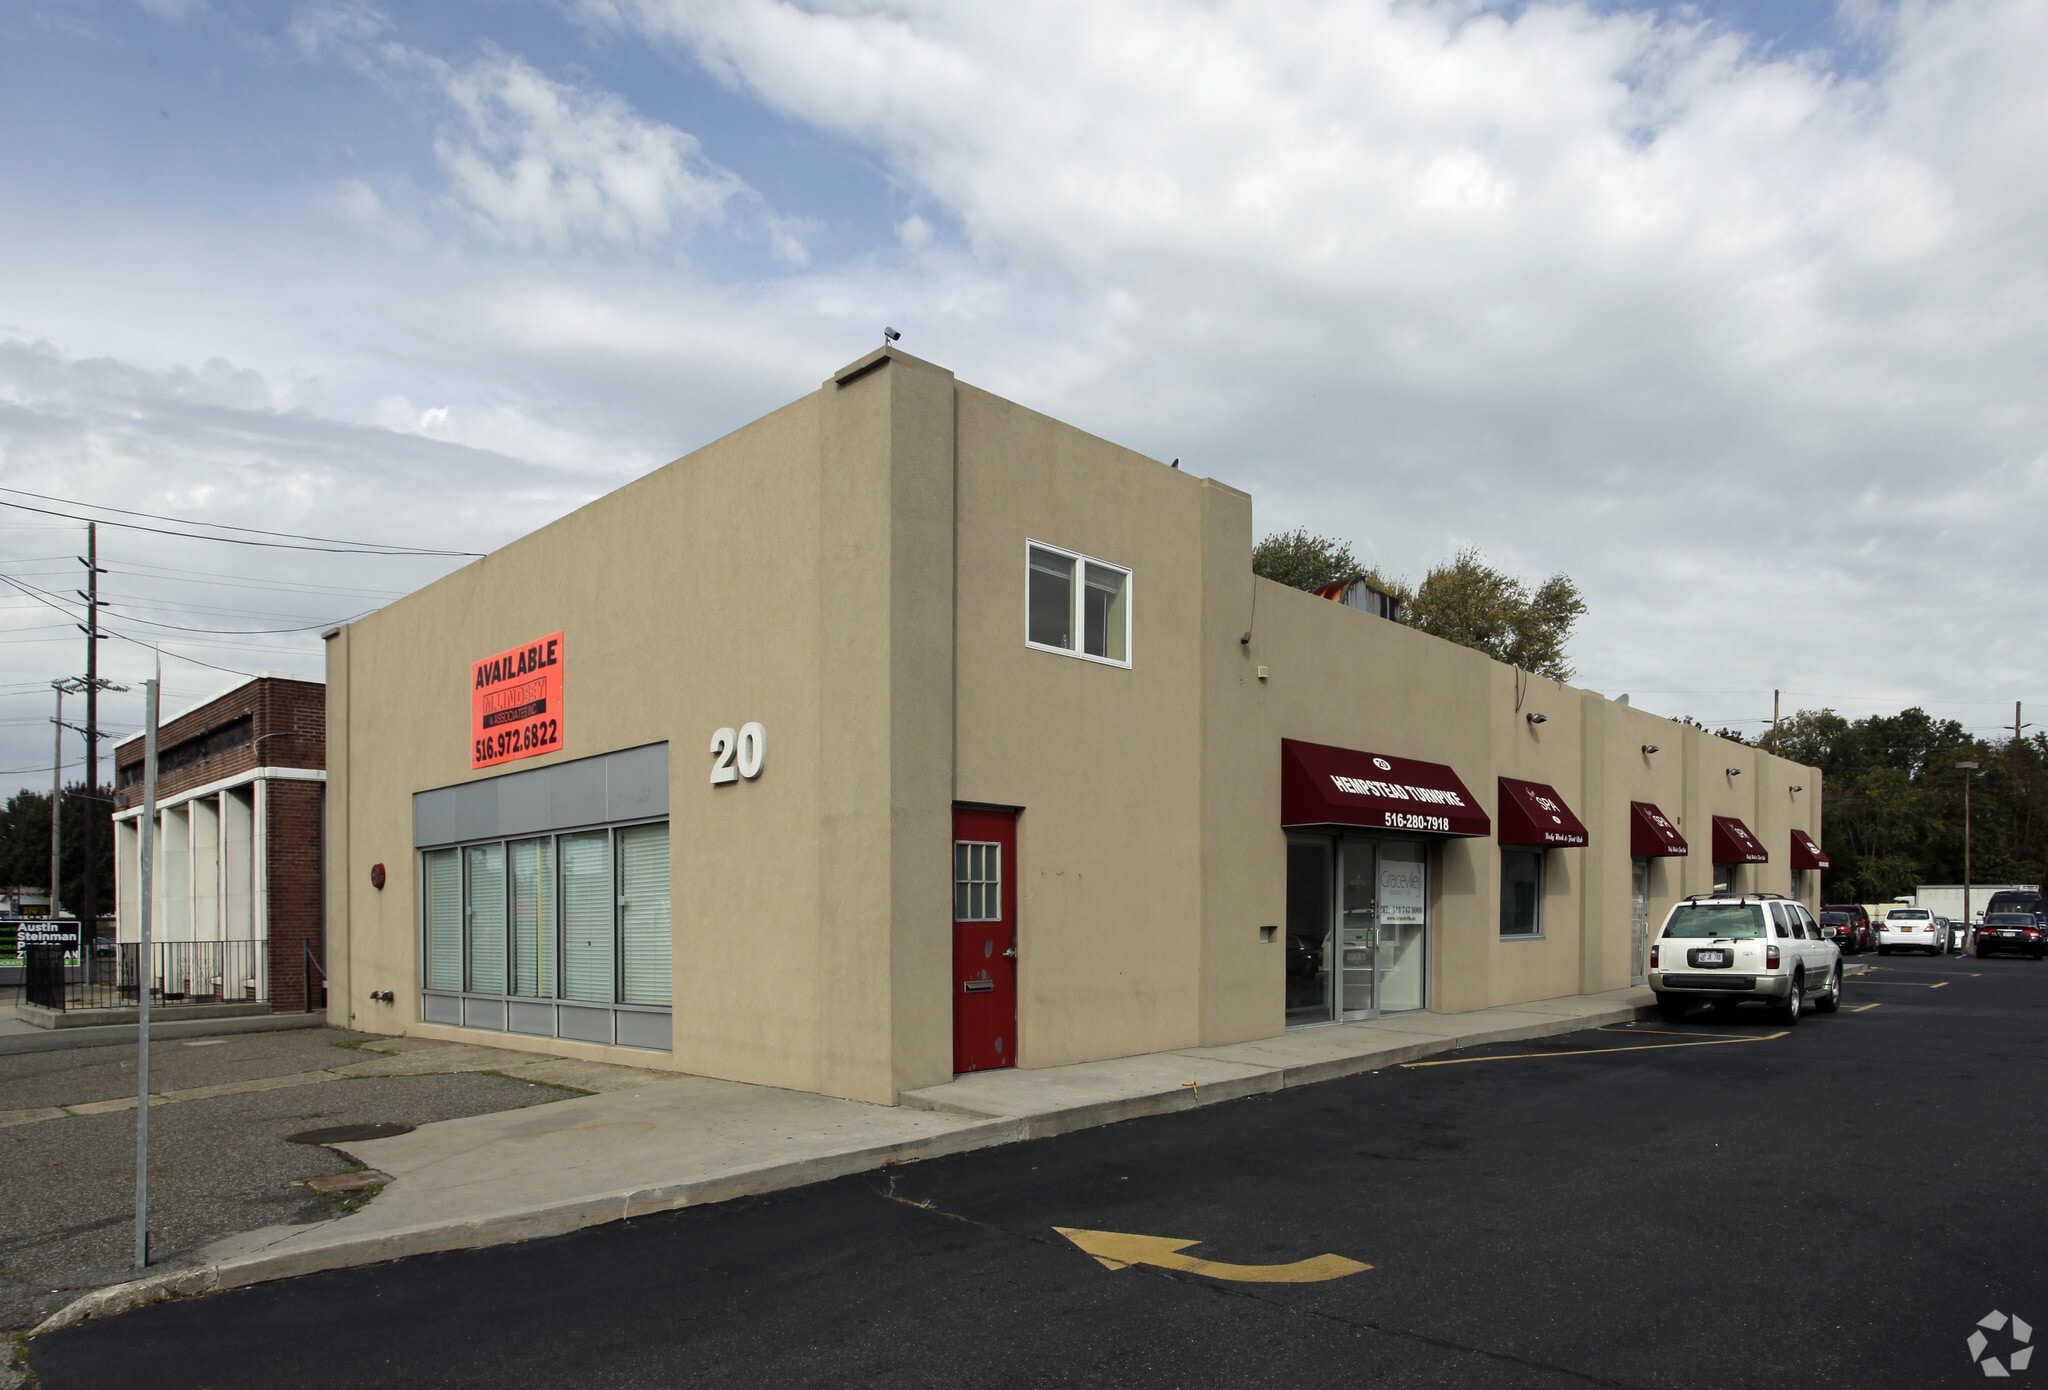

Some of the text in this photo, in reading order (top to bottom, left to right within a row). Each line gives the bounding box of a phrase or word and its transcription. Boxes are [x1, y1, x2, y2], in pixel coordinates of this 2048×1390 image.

[475, 639, 558, 690] AVAILABLE
[475, 718, 558, 762] 516.972.6822
[709, 721, 768, 784] 20
[1330, 775, 1465, 807] HEMPSTEAD TURNPIKE
[1535, 796, 1561, 813] SPA
[1384, 812, 1449, 831] 516-280-7918
[17, 922, 59, 932] Austin
[17, 932, 77, 941] Steinman
